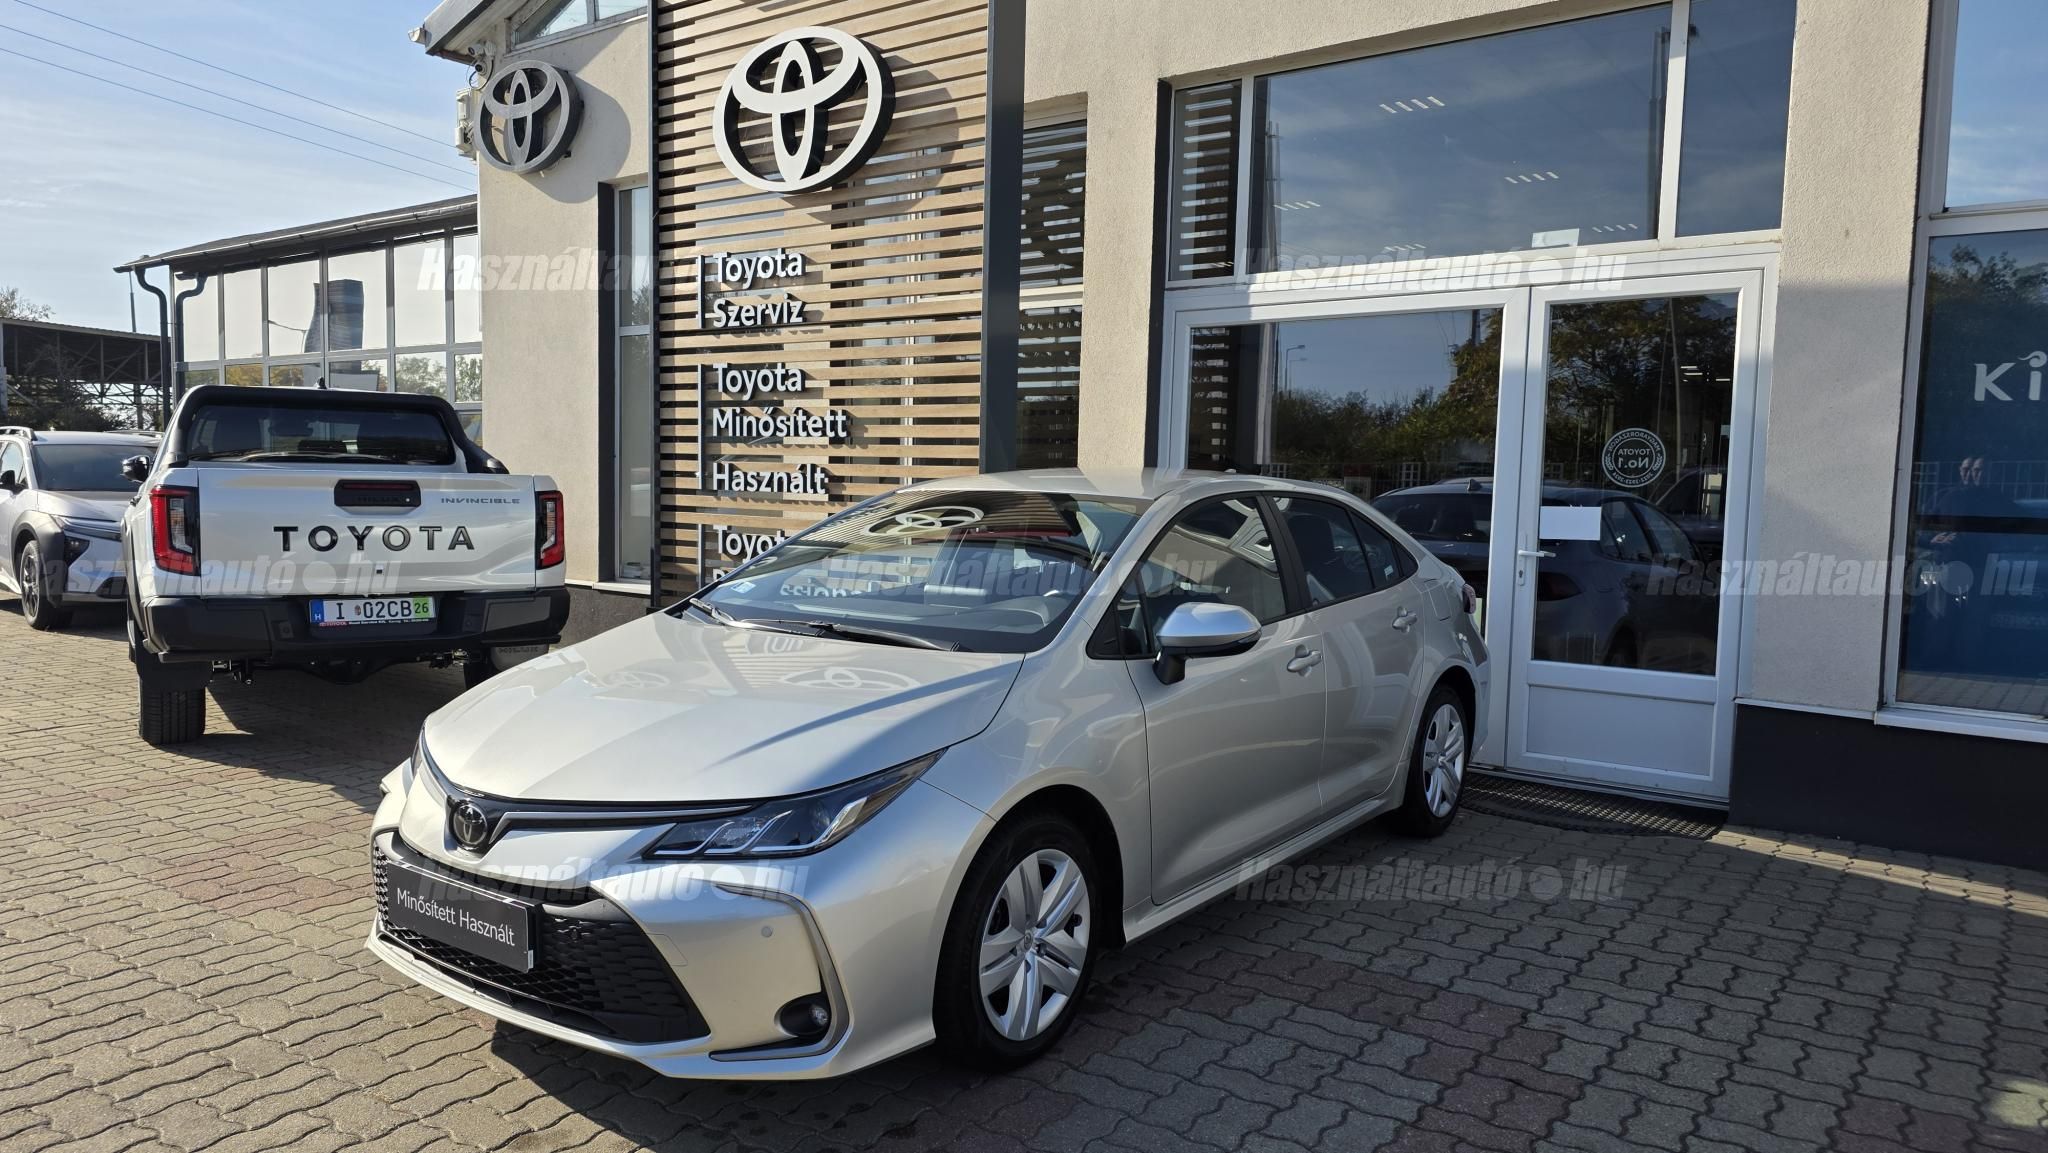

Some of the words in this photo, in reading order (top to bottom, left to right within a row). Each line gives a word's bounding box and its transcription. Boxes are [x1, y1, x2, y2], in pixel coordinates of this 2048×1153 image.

[712, 250, 803, 290] Toyota
[712, 293, 804, 328] Szerviz
[712, 362, 803, 400] Toyota
[712, 406, 847, 438] Minősített
[712, 462, 829, 495] Használt
[272, 525, 475, 552] TOYOTA
[712, 523, 788, 565] Toyot
[414, 602, 429, 614] 26
[396, 887, 457, 925] Minősített
[459, 908, 516, 947] Használt
